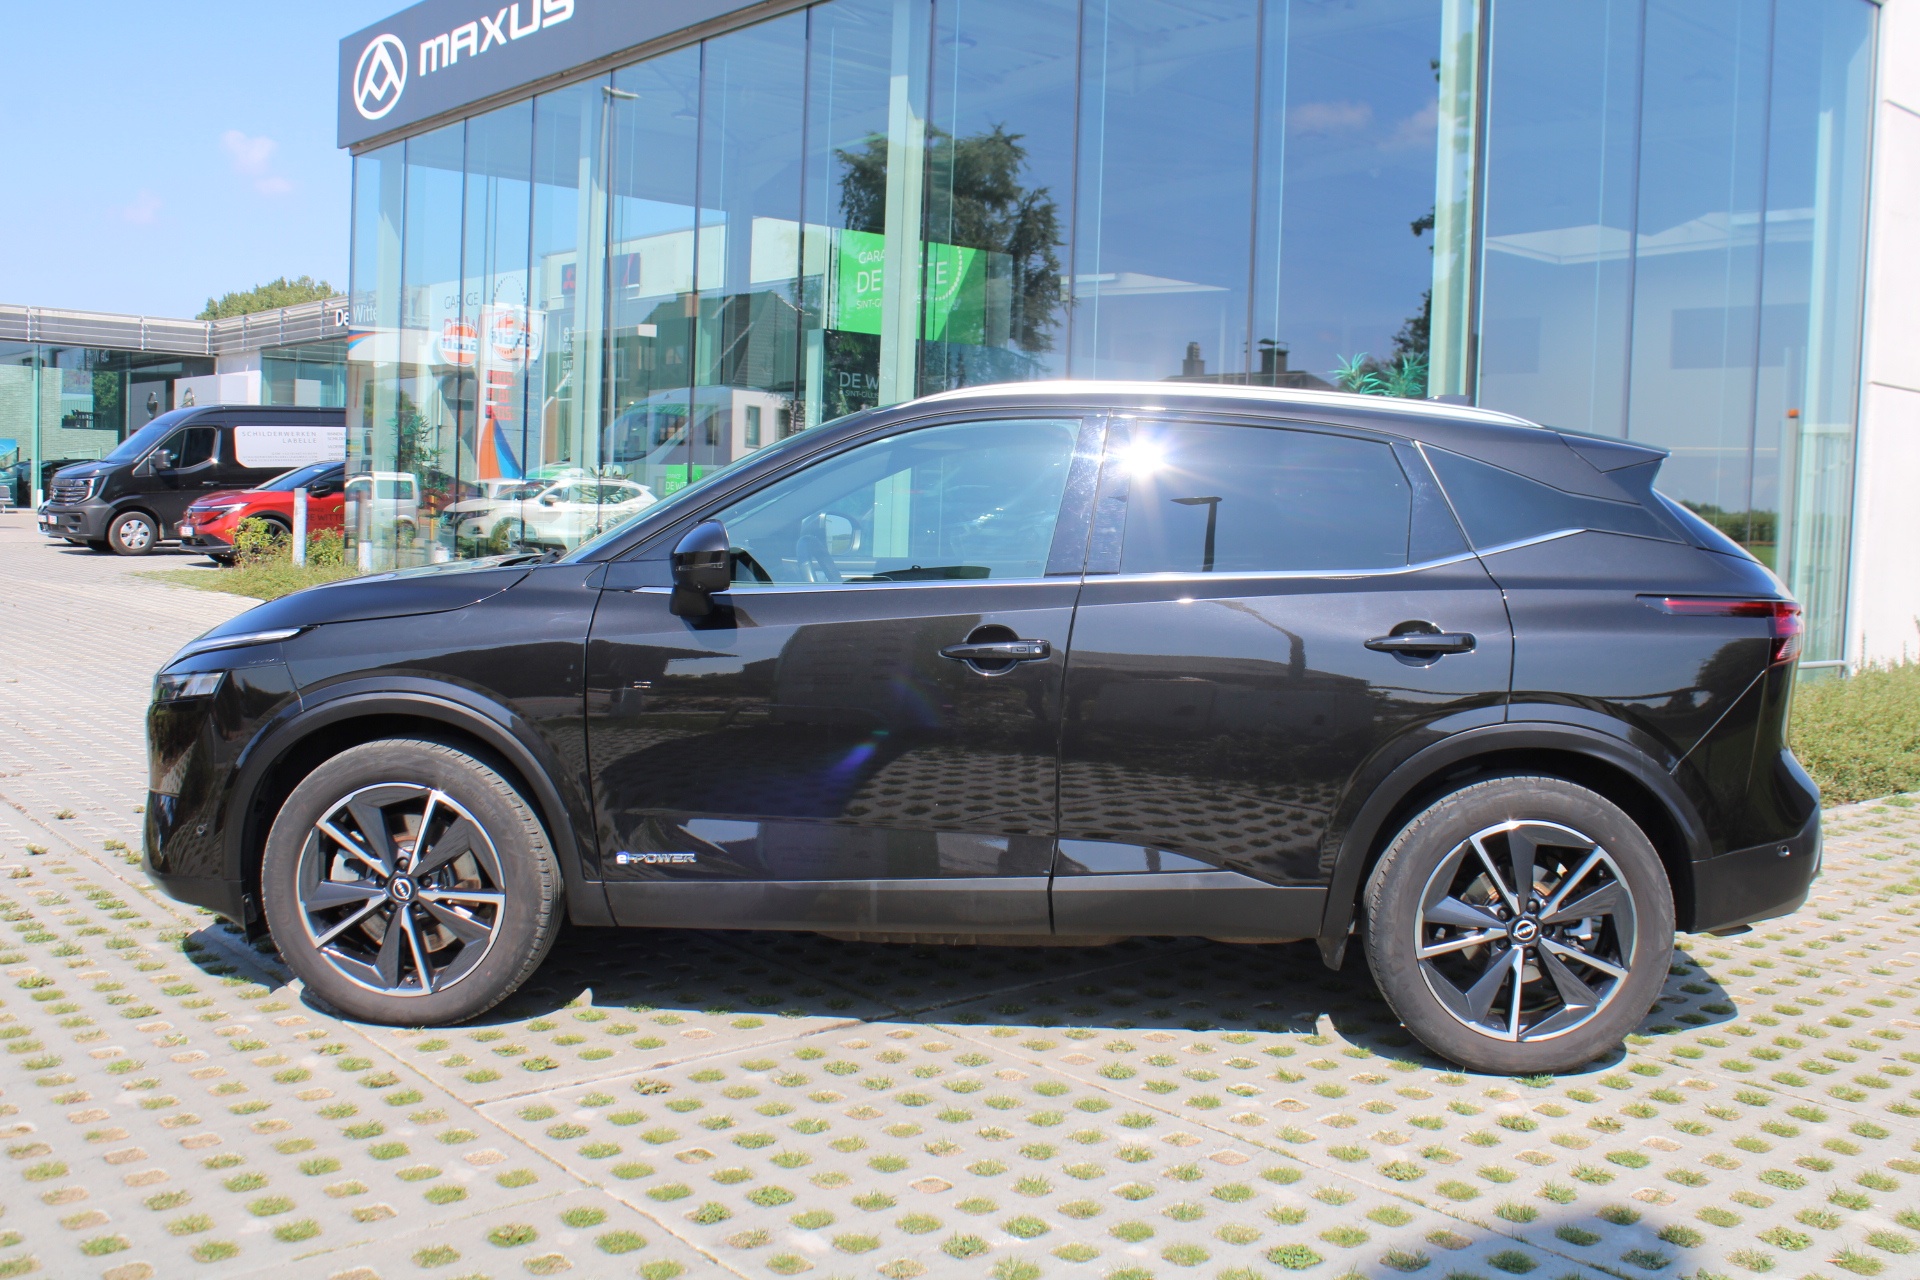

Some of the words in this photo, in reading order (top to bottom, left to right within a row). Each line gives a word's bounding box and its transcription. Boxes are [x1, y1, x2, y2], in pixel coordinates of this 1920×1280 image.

[419, 0, 575, 77] MAXUS
[857, 269, 882, 293] DE
[335, 308, 349, 327] De
[840, 371, 861, 389] DE
